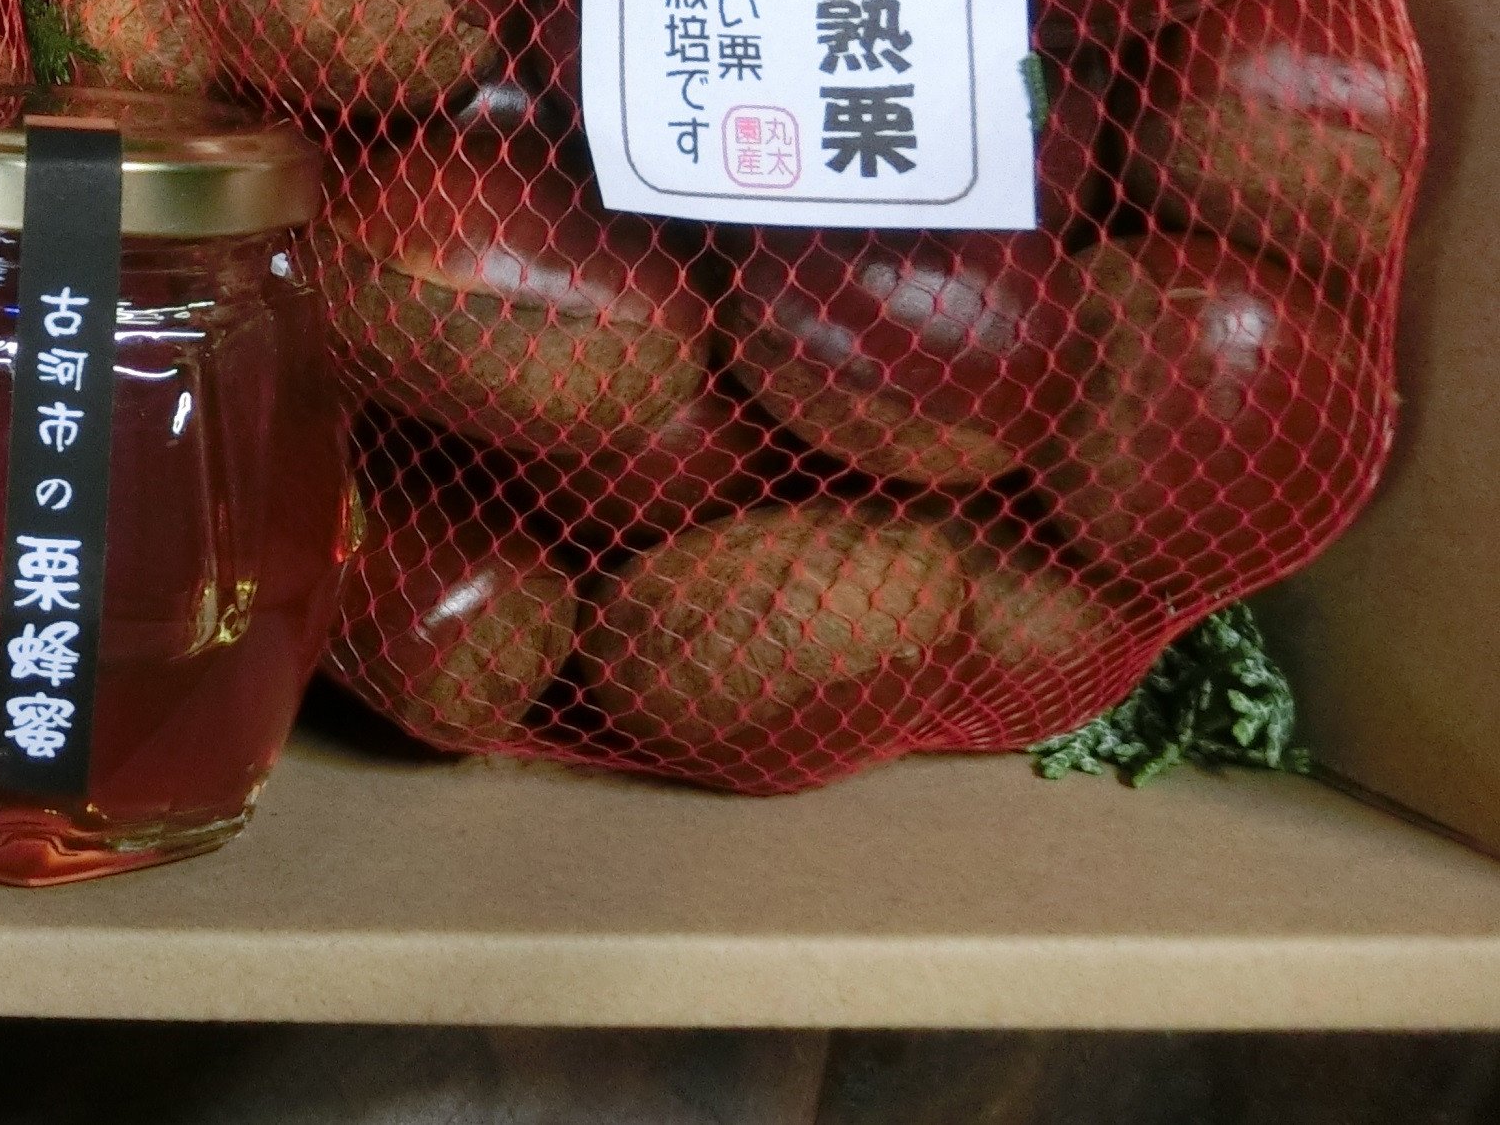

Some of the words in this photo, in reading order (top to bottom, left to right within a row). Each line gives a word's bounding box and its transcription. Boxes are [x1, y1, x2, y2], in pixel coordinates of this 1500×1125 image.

[5, 286, 90, 759] 古河市の栗蜂蜜
